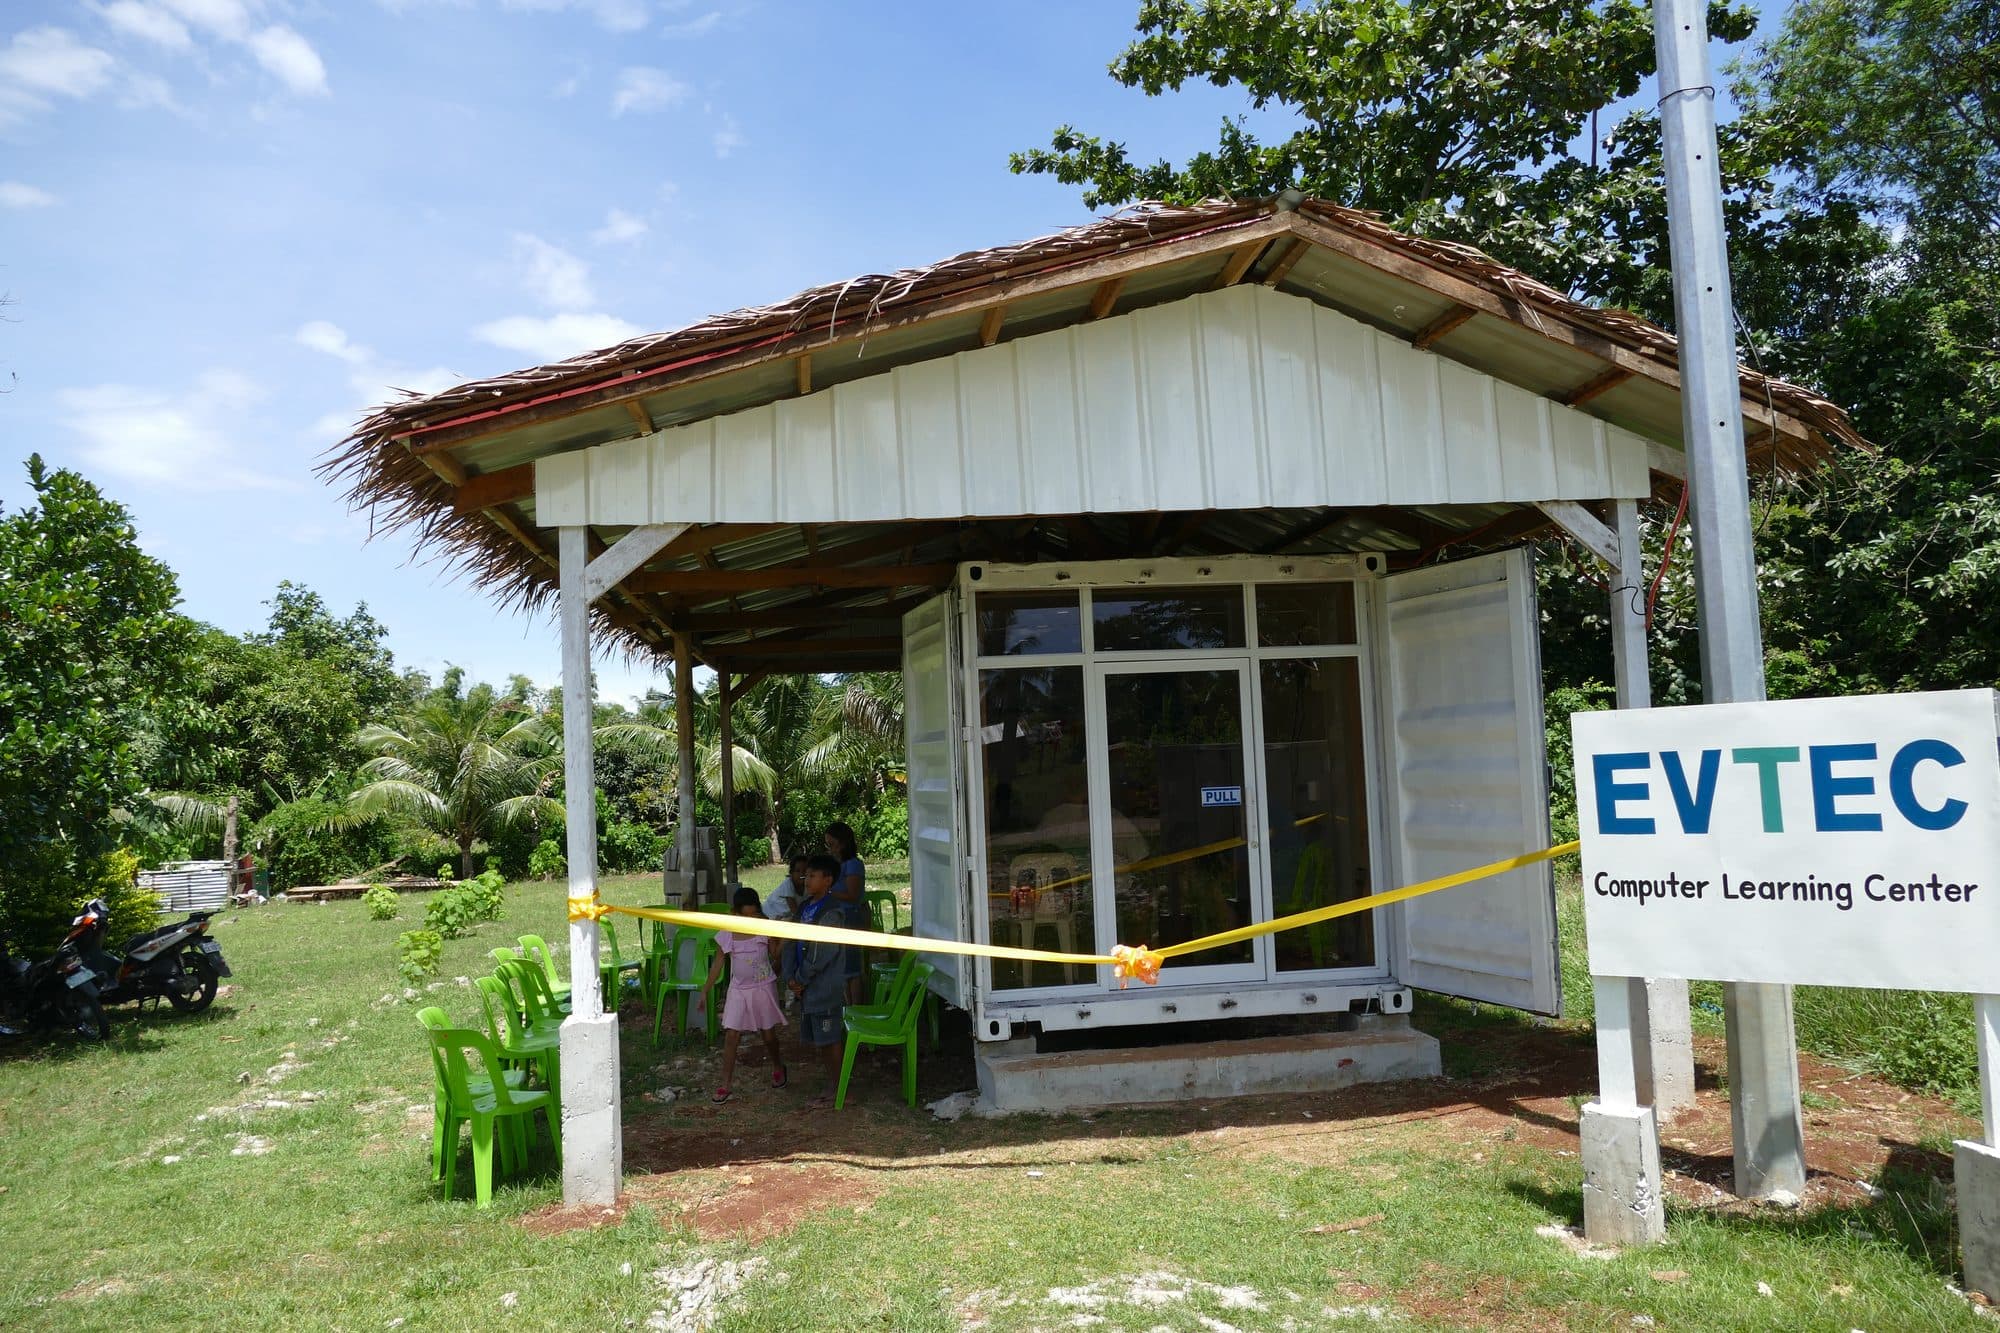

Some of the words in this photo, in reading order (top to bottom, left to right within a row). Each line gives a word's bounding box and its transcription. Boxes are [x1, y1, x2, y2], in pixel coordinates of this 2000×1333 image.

[1206, 791, 1237, 802] PULL
[1592, 738, 1969, 834] EVTEC
[1594, 871, 1710, 906] Computer
[1722, 873, 1853, 911] Learning
[1864, 873, 1979, 903] Center
